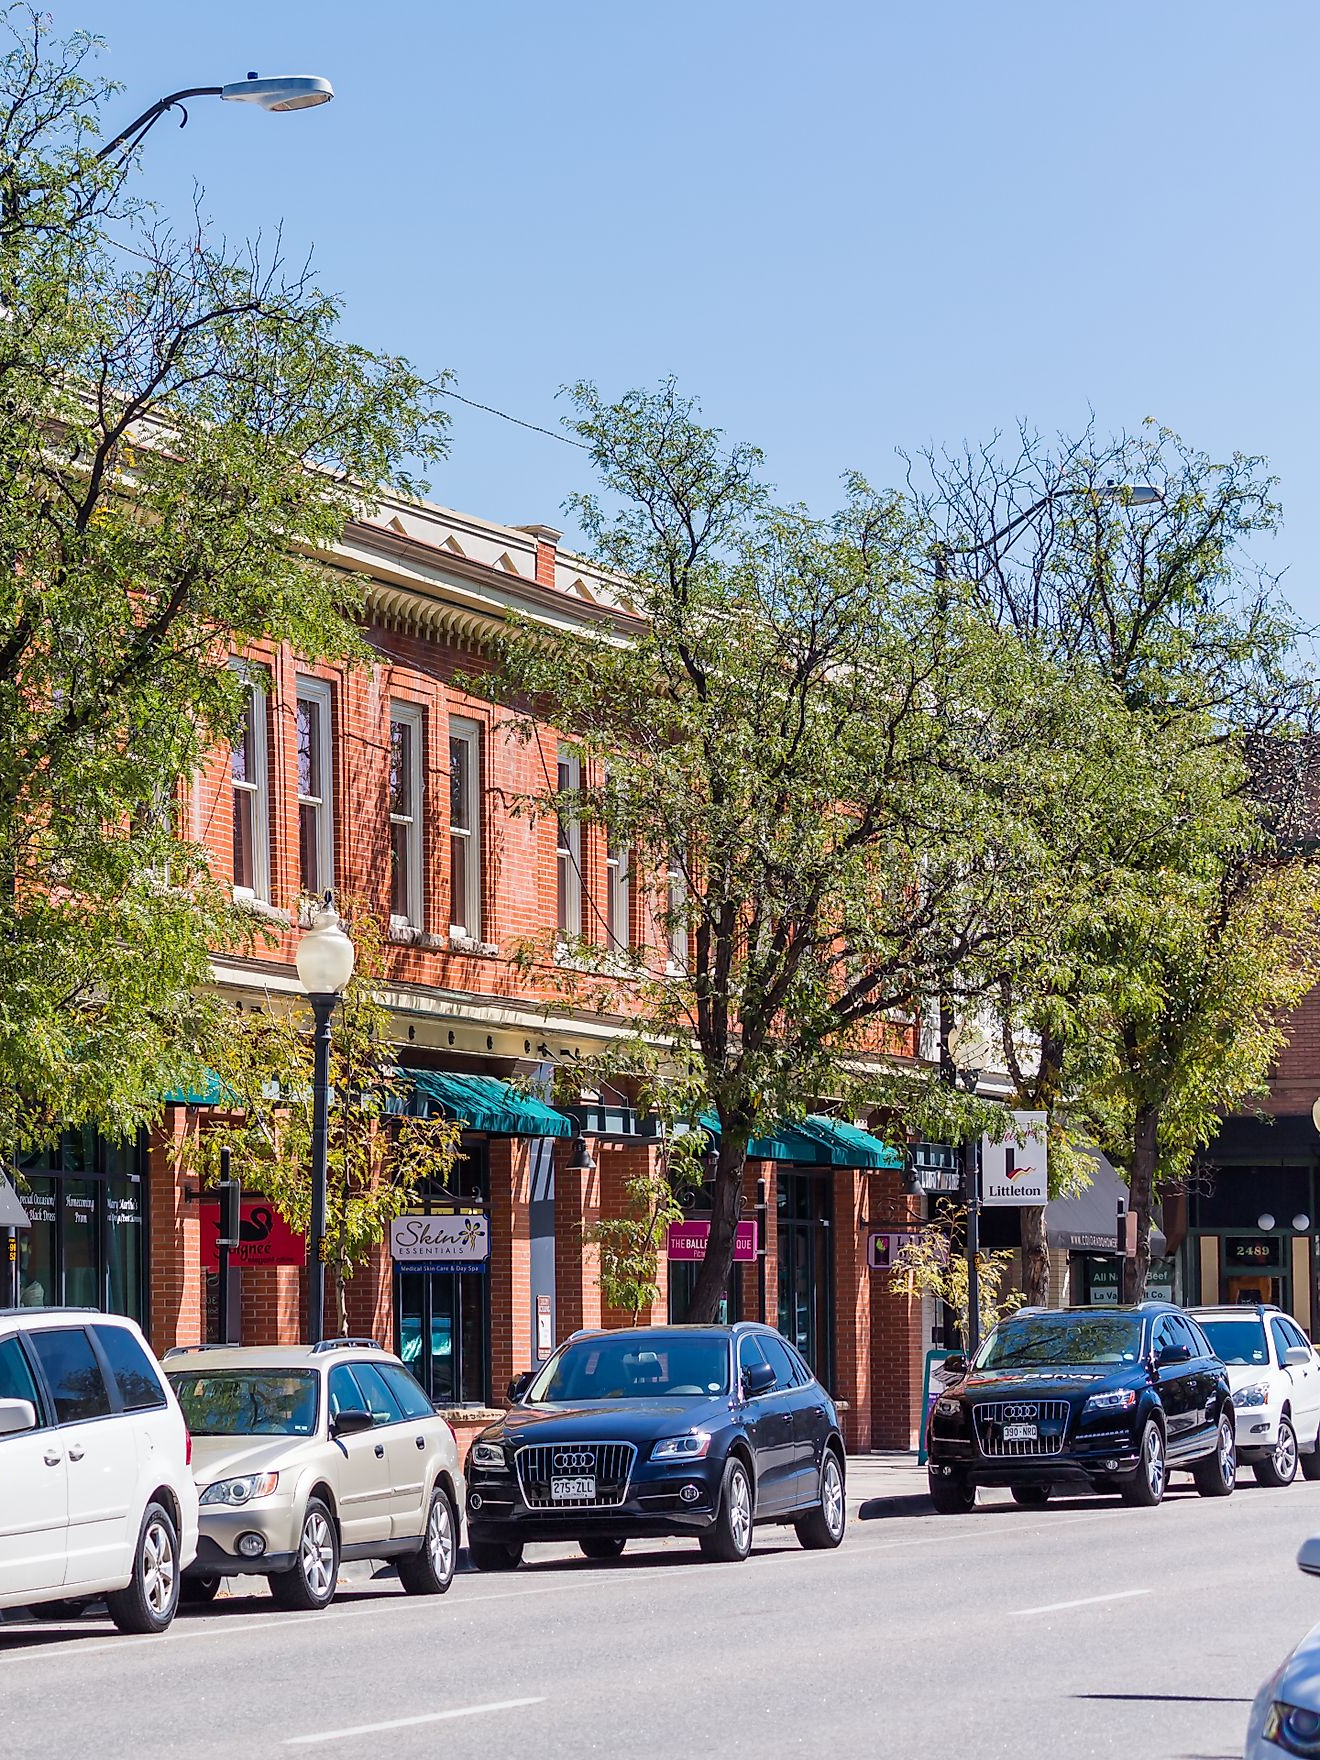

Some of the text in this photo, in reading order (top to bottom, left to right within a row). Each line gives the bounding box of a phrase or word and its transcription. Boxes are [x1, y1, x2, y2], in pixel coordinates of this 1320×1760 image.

[988, 1185, 1041, 1197] Littleton
[395, 1220, 462, 1247] Skin
[671, 1238, 708, 1249] THE BALLE
[399, 1247, 464, 1255] ESSENTIALS
[1236, 1246, 1270, 1256] 2489
[456, 1265, 467, 1273] Day
[468, 1265, 479, 1273] Spa
[1093, 1272, 1107, 1281] All
[1146, 1271, 1168, 1281] Beef
[1094, 1292, 1105, 1300] La
[1151, 1291, 1166, 1299] Co.
